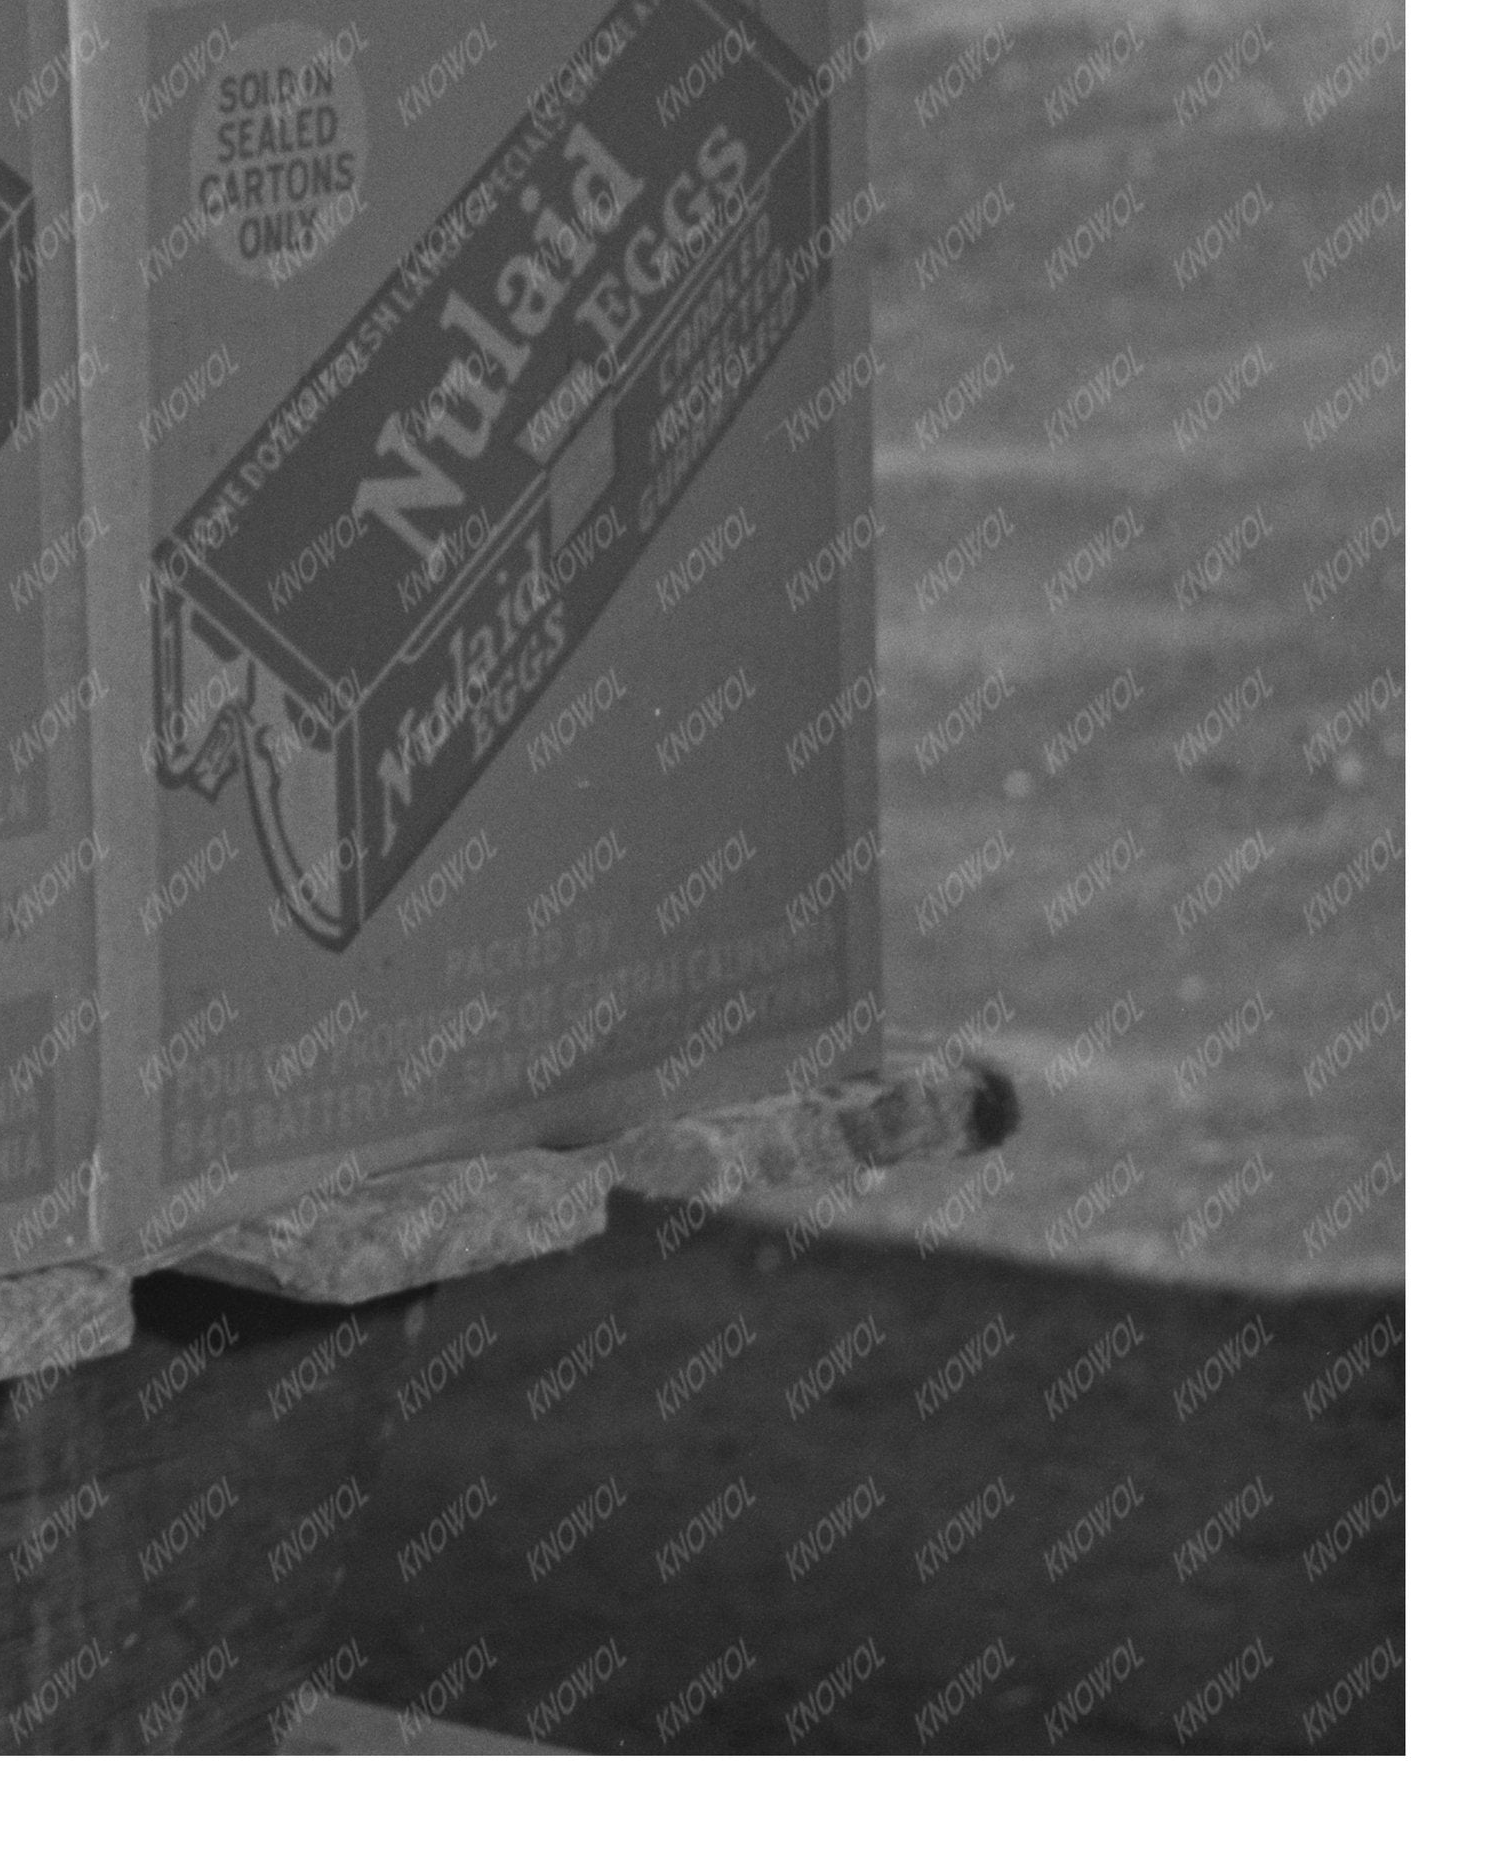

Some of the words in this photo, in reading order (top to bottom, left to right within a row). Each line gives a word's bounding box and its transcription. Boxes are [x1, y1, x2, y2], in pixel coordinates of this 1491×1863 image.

[217, 106, 338, 165] SEALED
[218, 69, 297, 116] SOLD
[305, 61, 333, 97] IN
[198, 152, 355, 217] CARTONS
[238, 209, 316, 261] ONLY
[575, 126, 750, 355] EGGS
[354, 124, 645, 581] Nulaid
[378, 528, 550, 859] Nulaid
[470, 603, 566, 764] EGGS
